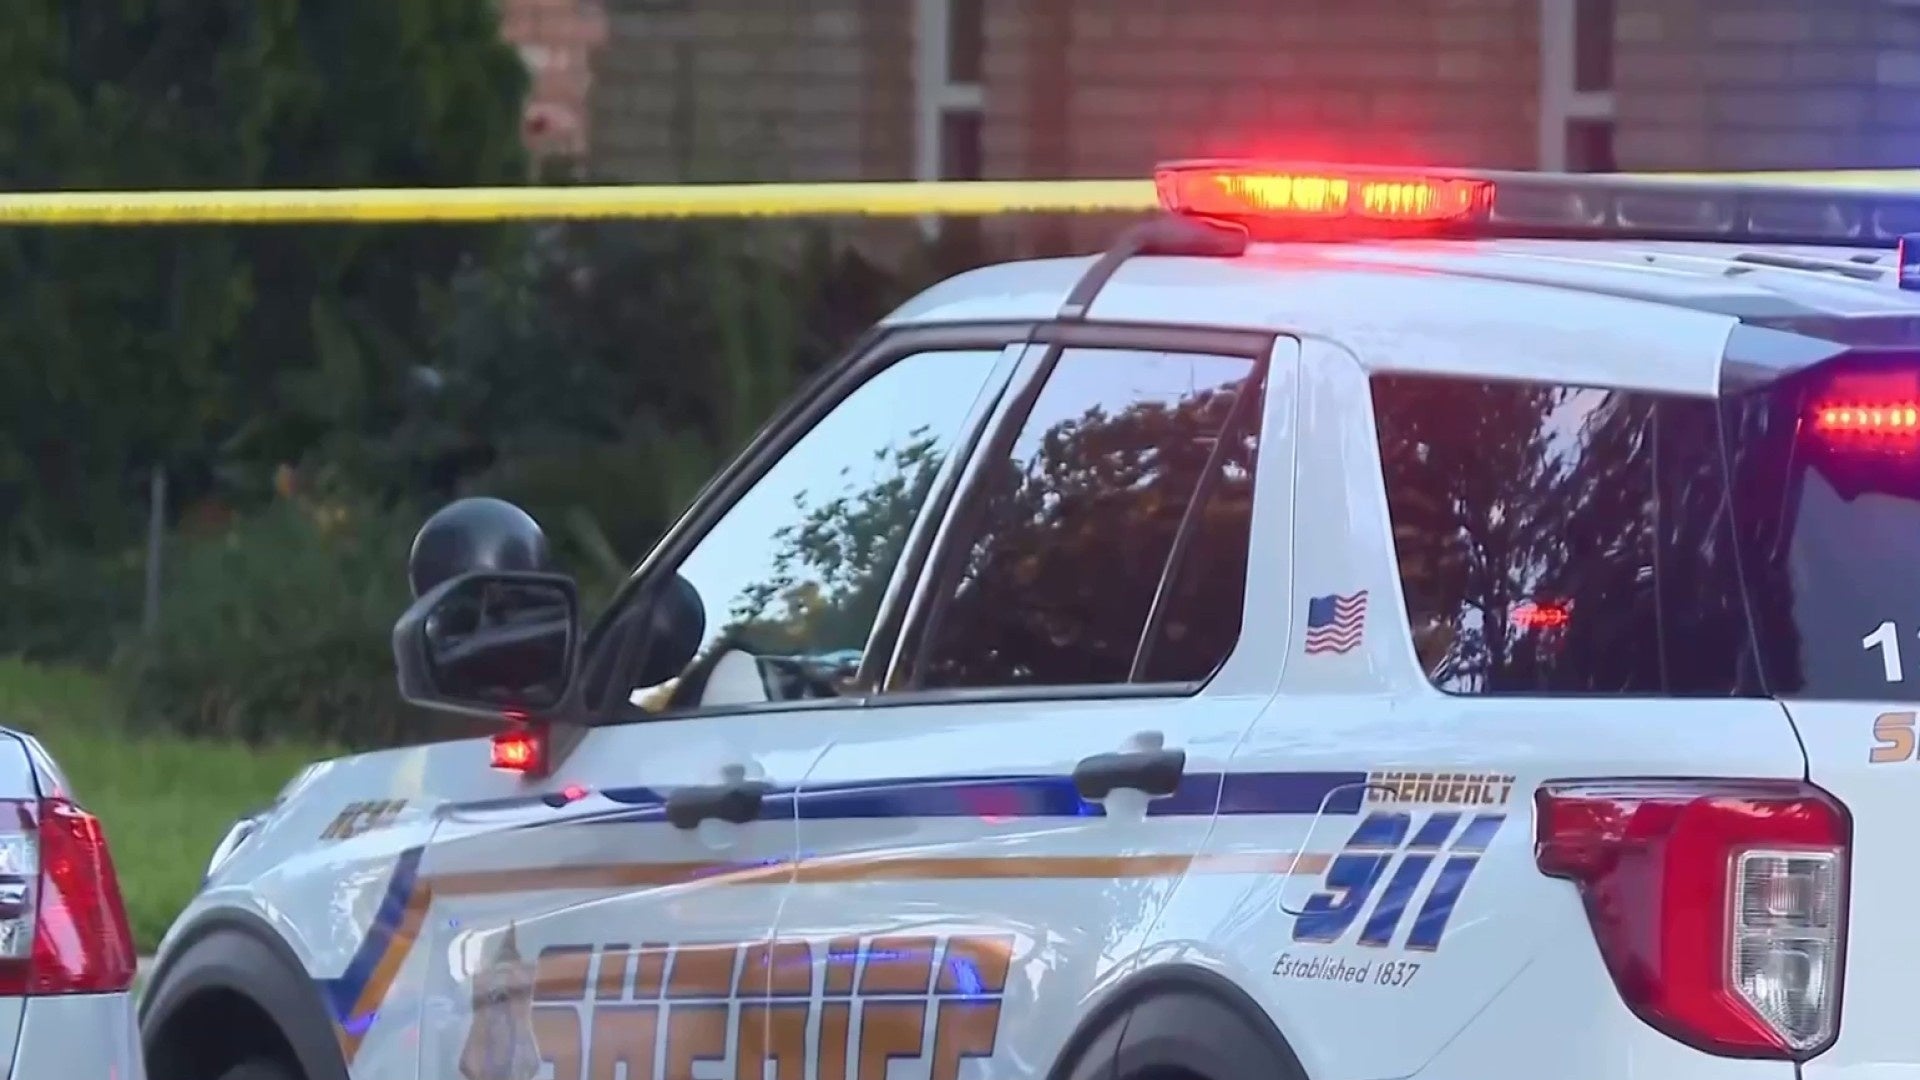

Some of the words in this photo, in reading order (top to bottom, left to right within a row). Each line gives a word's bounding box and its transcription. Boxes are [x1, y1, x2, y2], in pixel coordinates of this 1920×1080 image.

[1869, 712, 1920, 763] S
[1368, 771, 1516, 804] EMERGENCY
[1292, 812, 1507, 952] 911
[1272, 953, 1371, 983] Established
[1374, 962, 1420, 987] 1837
